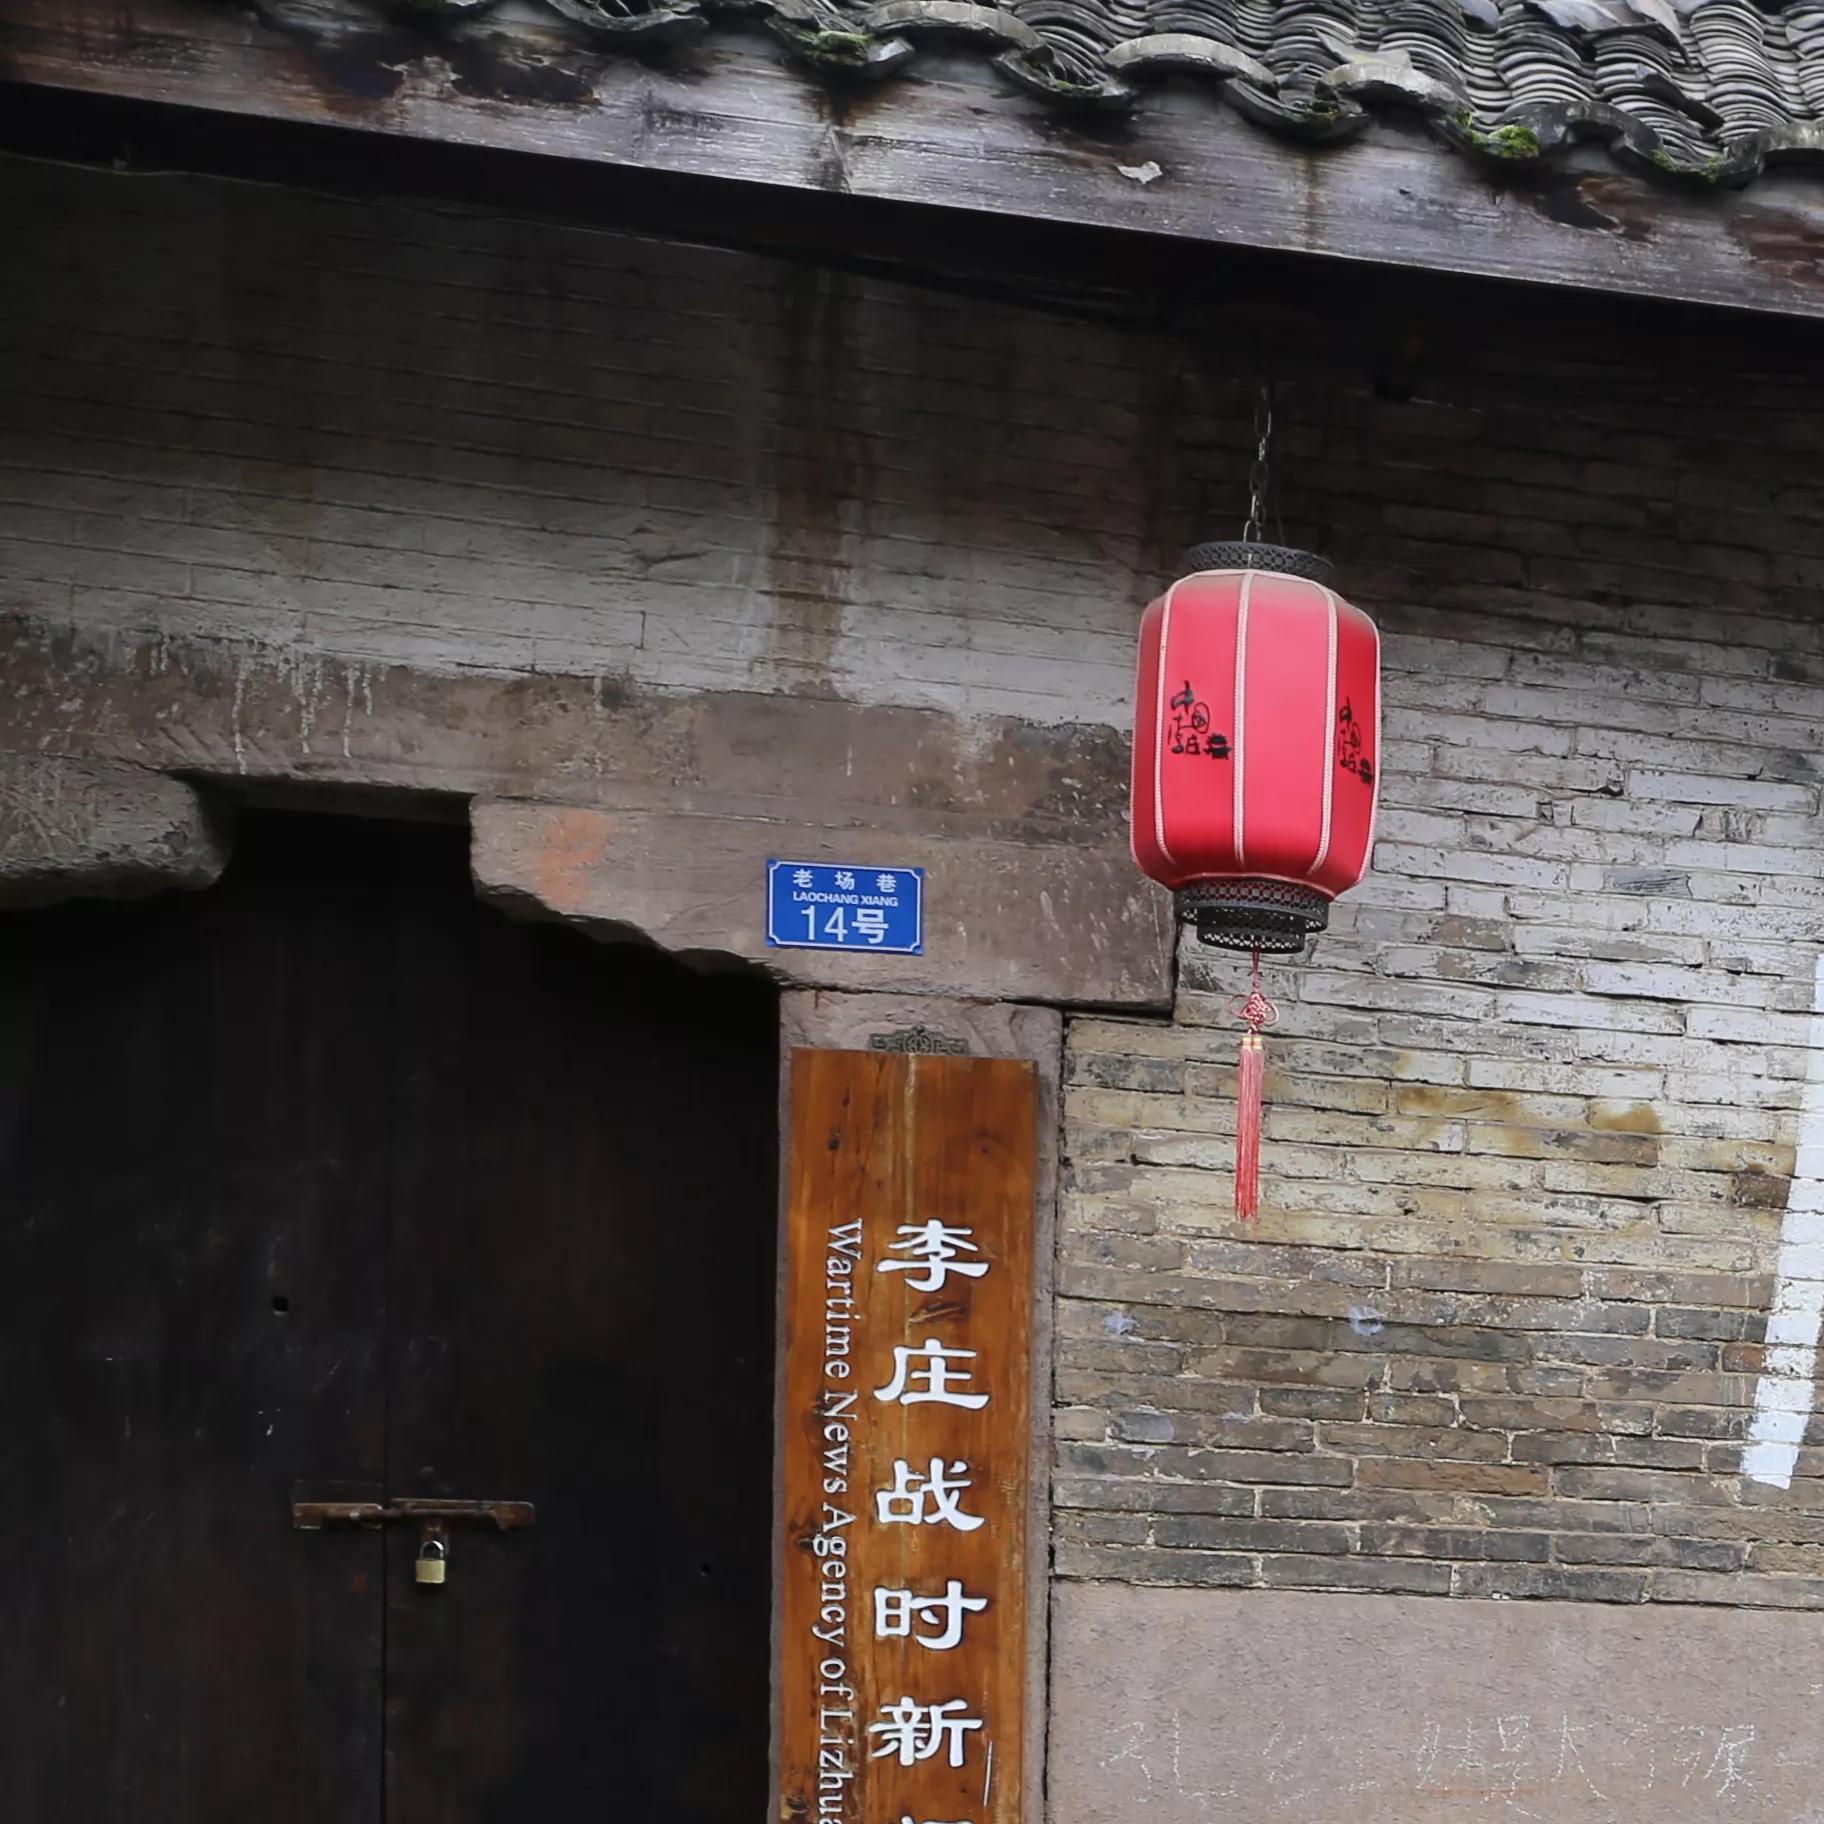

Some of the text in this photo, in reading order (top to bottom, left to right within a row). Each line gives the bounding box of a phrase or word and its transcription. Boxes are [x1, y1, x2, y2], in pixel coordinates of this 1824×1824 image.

[792, 869, 897, 893] 老场巷
[792, 891, 899, 907] LAOCHANG XIANG
[801, 905, 889, 944] 14号
[824, 1217, 863, 1379] Wartime
[822, 1390, 858, 1494] News
[812, 1502, 856, 1647] Agency
[819, 1658, 854, 1701] of
